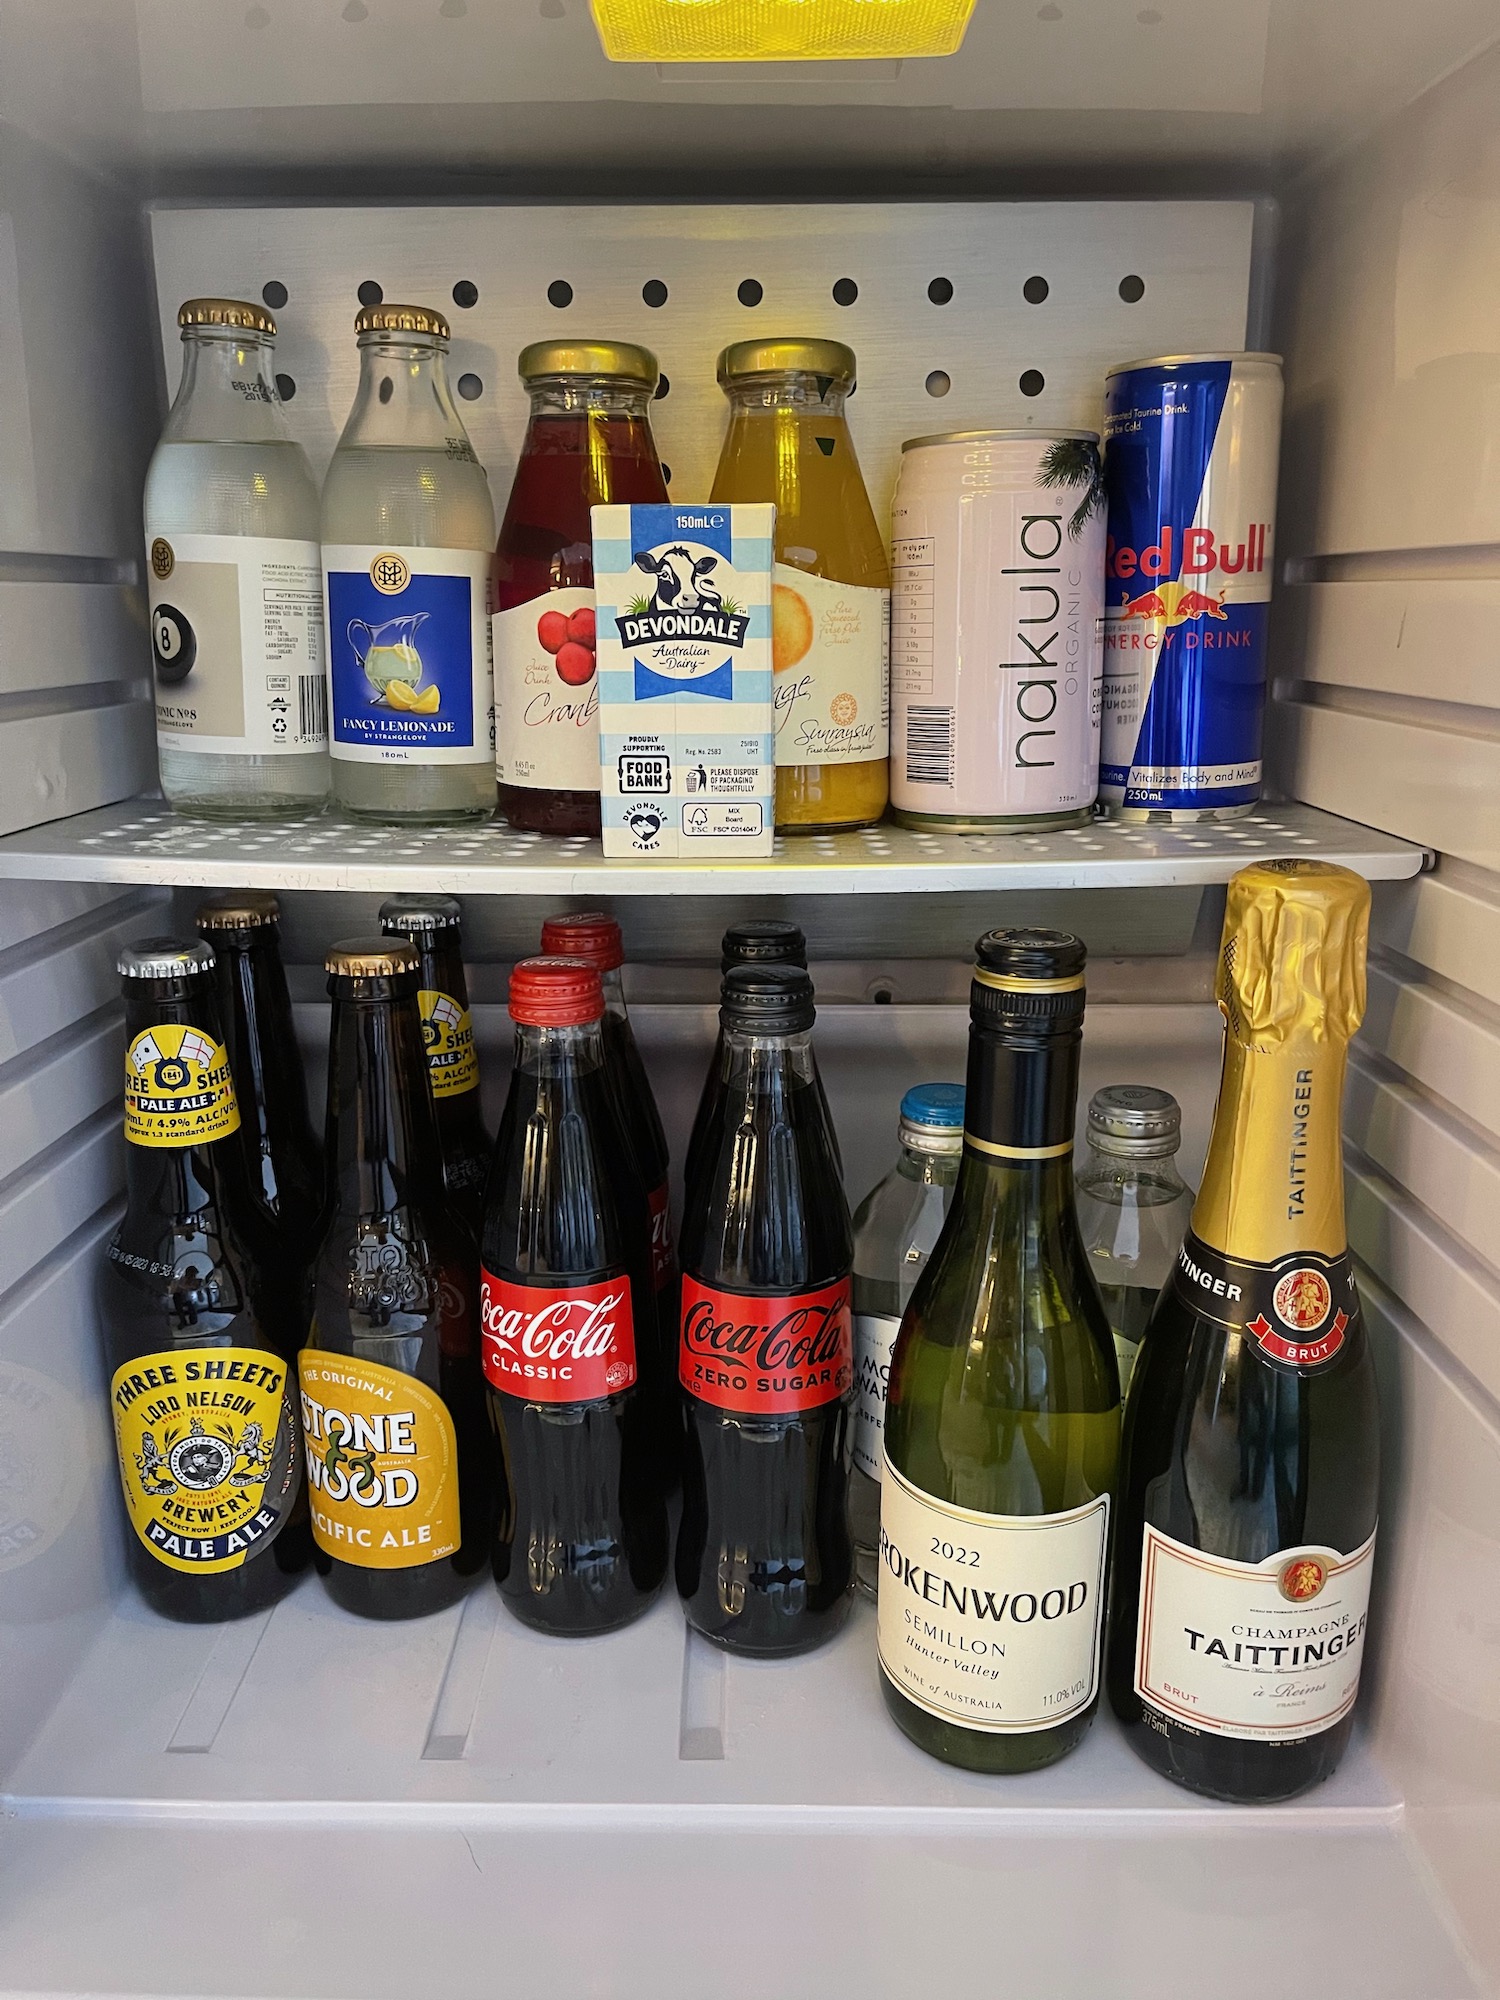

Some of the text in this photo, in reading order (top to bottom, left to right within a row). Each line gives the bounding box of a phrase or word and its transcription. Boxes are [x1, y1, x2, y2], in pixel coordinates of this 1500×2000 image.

[1134, 408, 1162, 418] Taurine
[1164, 403, 1190, 415] Drink.
[1124, 421, 1142, 432] Cold.
[1182, 524, 1265, 574] Bull
[161, 626, 171, 651] 8
[624, 616, 741, 641] DEVONDALE
[1064, 570, 1082, 696] ORGANIC
[1186, 631, 1252, 649] DRINK
[652, 644, 710, 658] Australian
[999, 515, 1062, 768] nakula
[526, 658, 550, 672] Juice
[343, 718, 456, 733] FANCY LEMONADE
[374, 733, 426, 741] STRANGELOVE
[626, 762, 662, 774] FOOD
[1132, 770, 1178, 783] Vitalizes
[1182, 772, 1211, 786] Body
[1214, 768, 1232, 782] and
[626, 775, 663, 787] BANK
[622, 802, 668, 822] DEVONDALE
[632, 841, 660, 850] CARES
[430, 1054, 454, 1066] ALE
[140, 1094, 208, 1111] PALE ALE
[157, 1118, 190, 1128] 4.9%
[166, 1126, 204, 1138] standard
[208, 1119, 228, 1132] drinks
[1288, 1068, 1313, 1220] TAITTINGER
[481, 1282, 624, 1360] Coca-Cola
[684, 1294, 848, 1371] Coca-Cola
[1286, 1342, 1328, 1359] BRUT
[492, 1353, 572, 1380] CLASSIC
[694, 1362, 747, 1390] ZERO
[756, 1369, 830, 1392] SUGAR
[116, 1361, 282, 1412] THREE SHEETS
[304, 1370, 394, 1402] THE ORIGINAL
[140, 1392, 256, 1426] LORD NELSON
[192, 1408, 230, 1418] AUSTRALIA
[300, 1389, 416, 1454] STONE
[304, 1441, 418, 1508] WOOD
[162, 1490, 250, 1522] BREWERY
[162, 1517, 189, 1532] PERFECT
[220, 1518, 237, 1530] KEEP
[238, 1505, 256, 1520] COOL
[149, 1510, 275, 1558] PALE ALE
[380, 1524, 432, 1548] ALE
[930, 1538, 981, 1568] 2022
[880, 1526, 1088, 1623] ROKENWOOD
[904, 1609, 1006, 1657] SEMILLON
[1184, 1611, 1366, 1666] TAITTINGER
[1231, 1614, 1350, 1639] CHAMPAGNE
[906, 1635, 1000, 1680] Hunter Valley
[904, 1665, 1002, 1710] WINE of AUSTRALIA
[1043, 1678, 1086, 1706] 11.0% VOL
[1164, 1682, 1198, 1704] BRUT
[1252, 1685, 1264, 1697] à
[1269, 1680, 1326, 1698] Reims
[1142, 1708, 1170, 1738] 375mL
[1174, 1722, 1200, 1736] FRANCE
